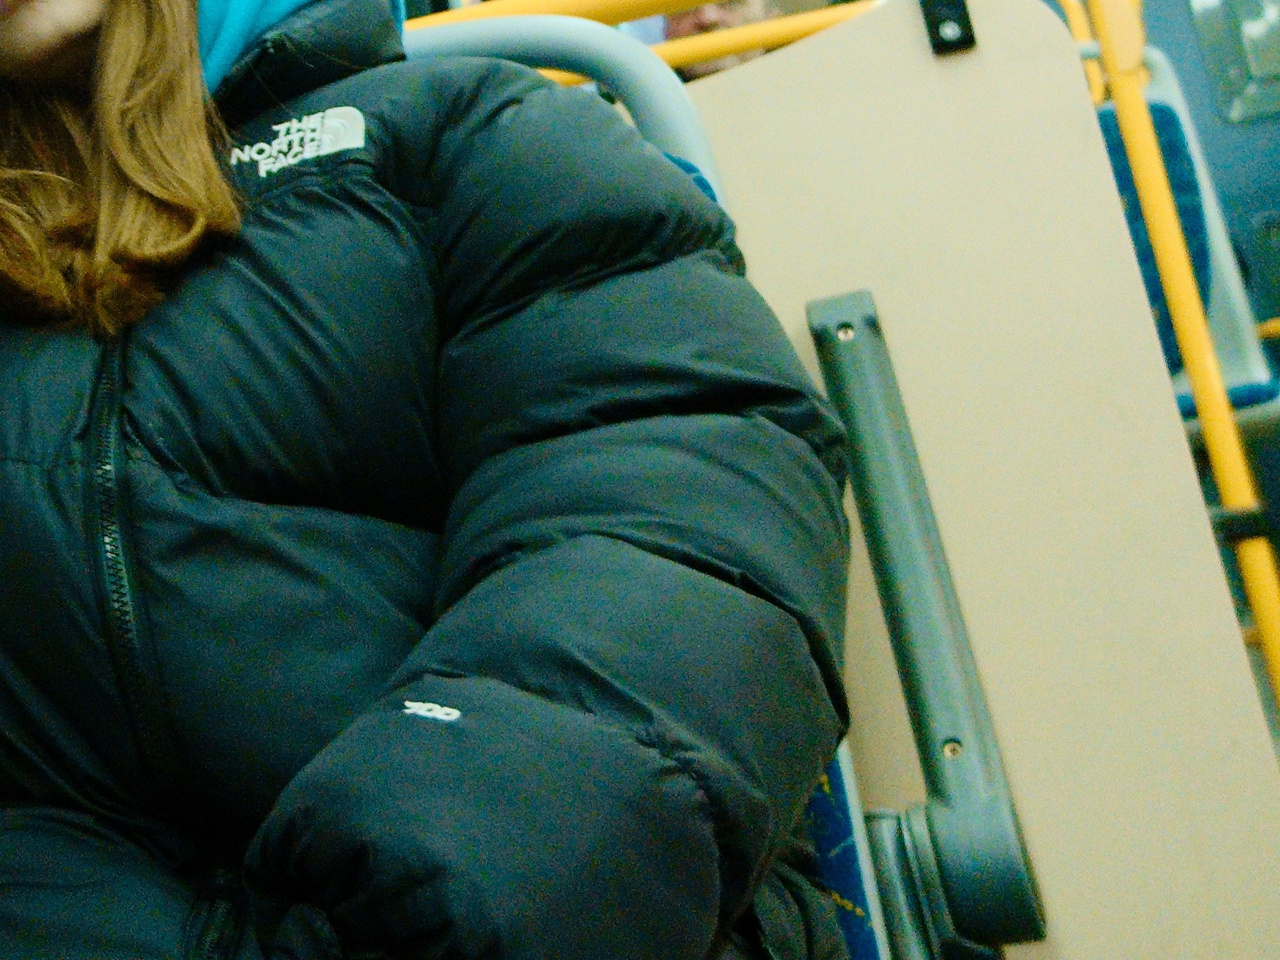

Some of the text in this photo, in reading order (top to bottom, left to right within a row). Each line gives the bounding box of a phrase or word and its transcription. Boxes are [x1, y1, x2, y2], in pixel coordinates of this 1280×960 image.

[271, 111, 324, 137] THE
[230, 128, 322, 165] NORTH
[258, 141, 321, 178] FACE
